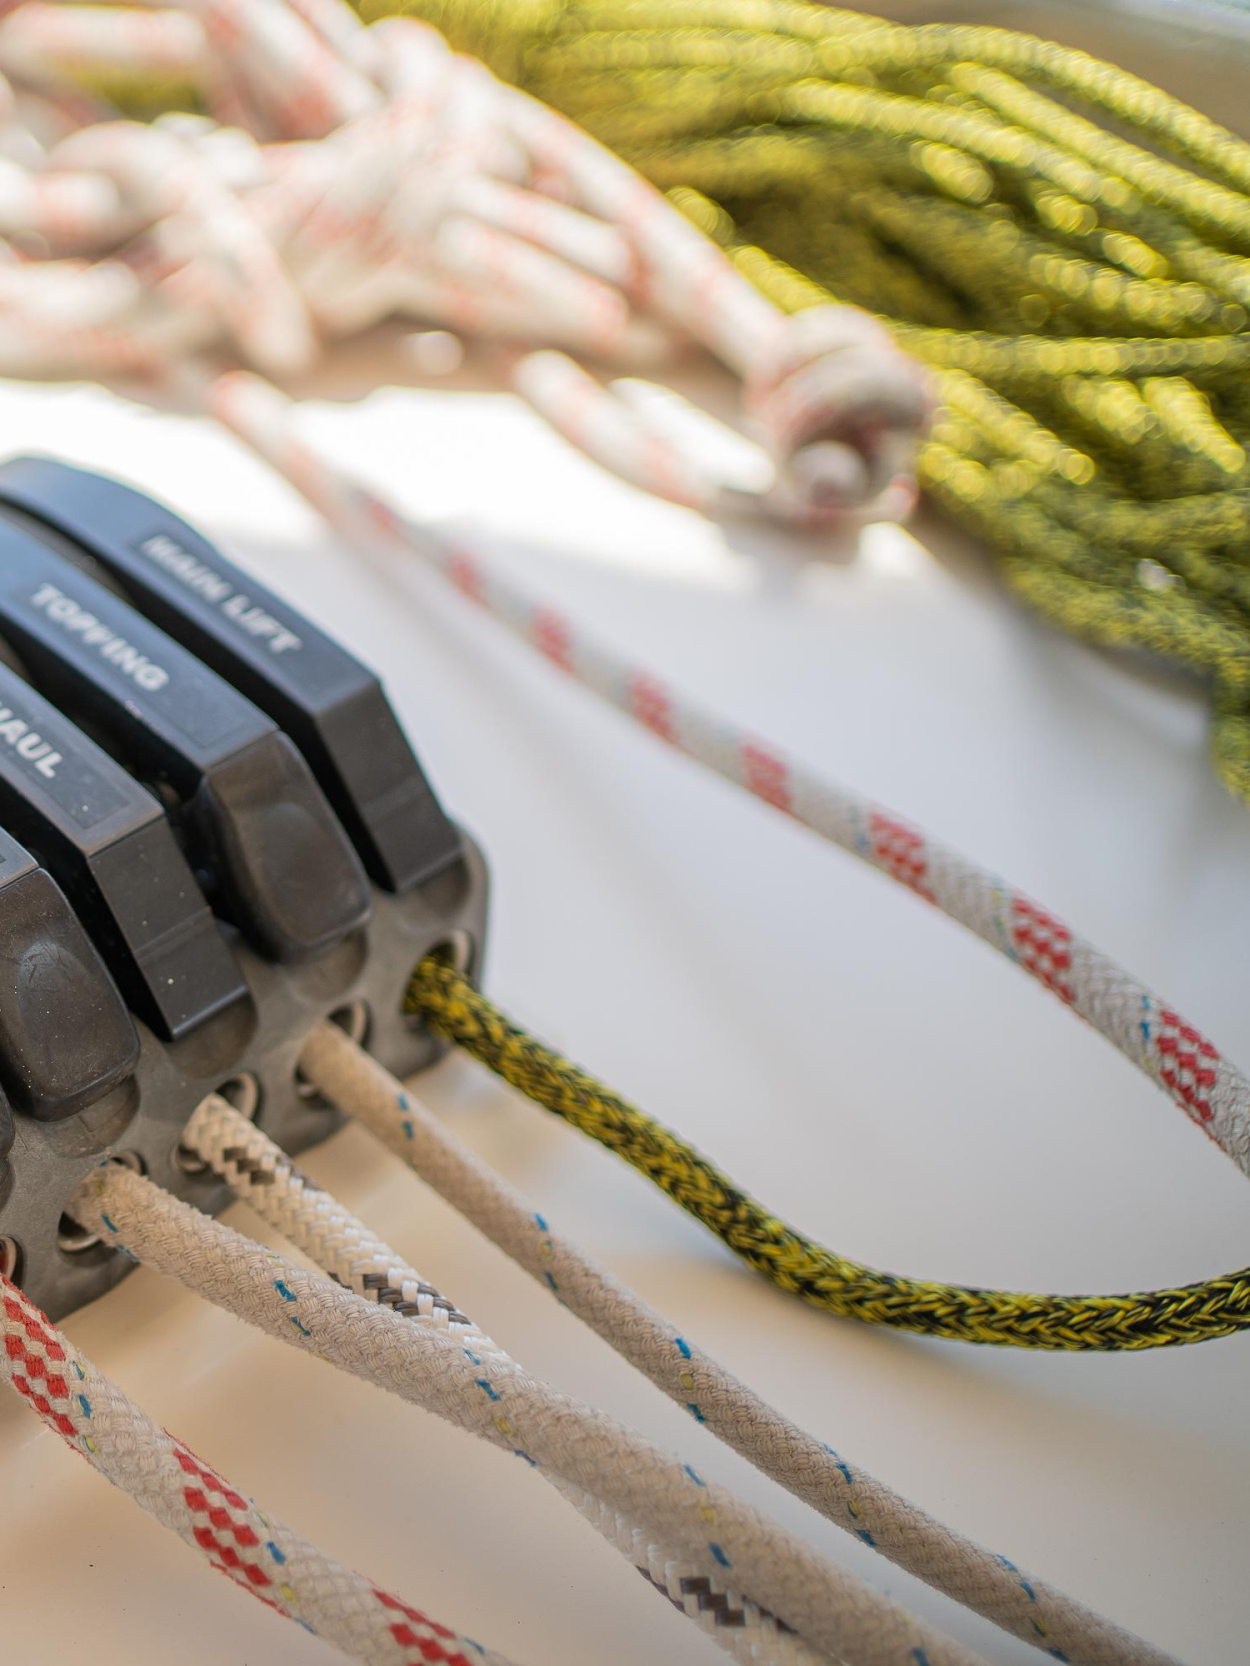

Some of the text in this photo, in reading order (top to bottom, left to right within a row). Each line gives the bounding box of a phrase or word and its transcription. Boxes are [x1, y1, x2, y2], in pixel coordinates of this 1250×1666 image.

[32, 583, 169, 691] TOPPING
[142, 535, 301, 653] MAIN LIFT
